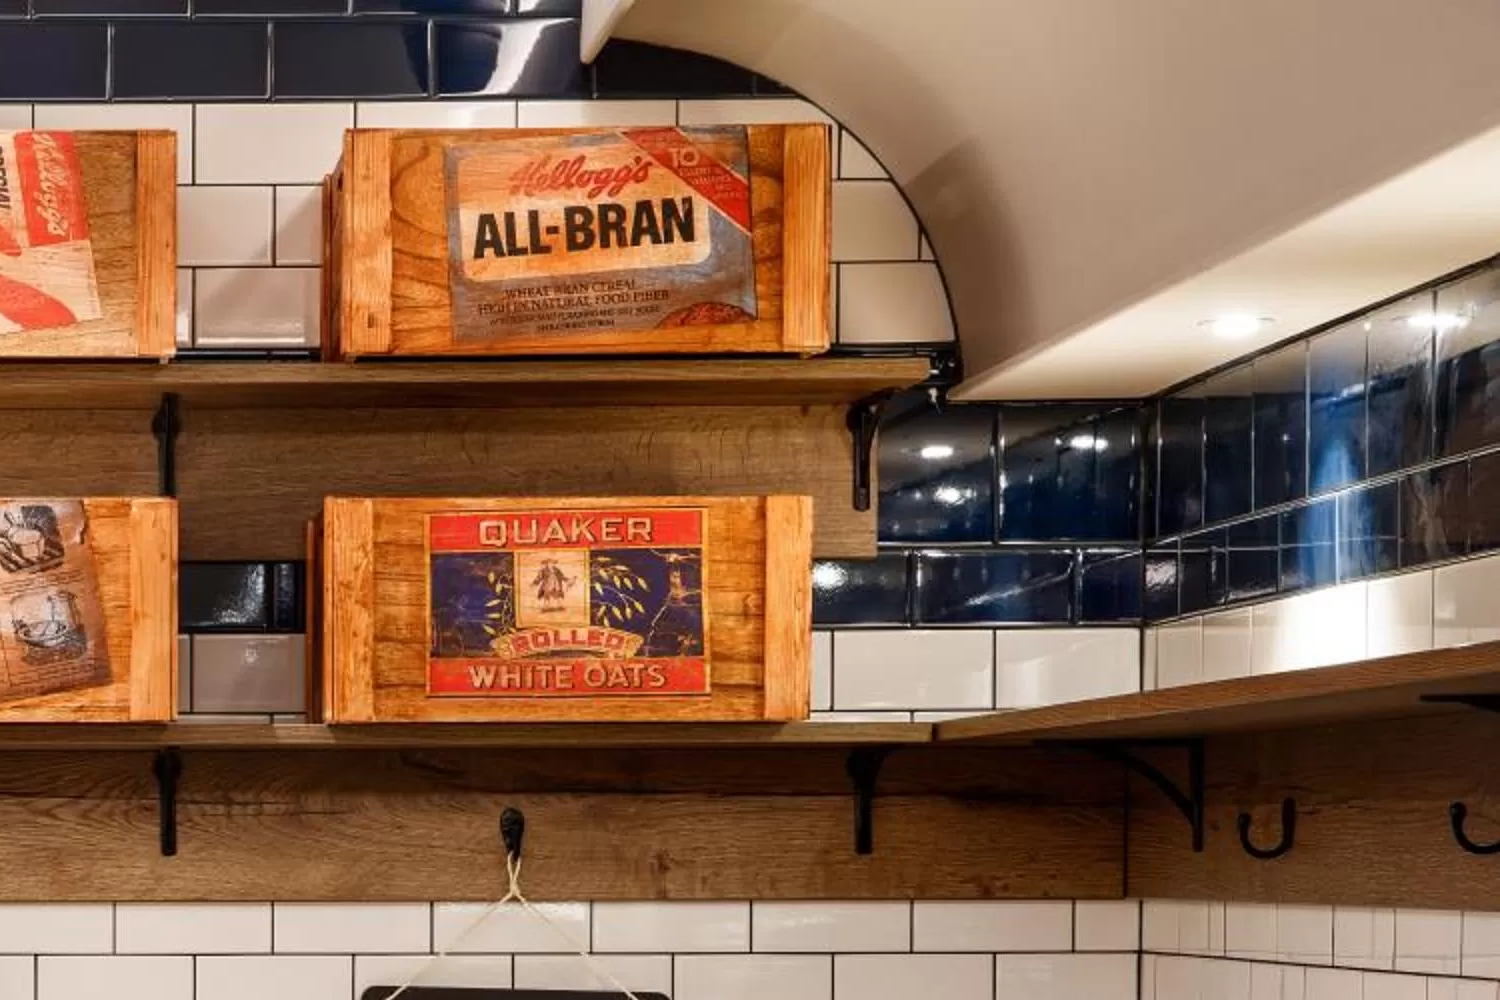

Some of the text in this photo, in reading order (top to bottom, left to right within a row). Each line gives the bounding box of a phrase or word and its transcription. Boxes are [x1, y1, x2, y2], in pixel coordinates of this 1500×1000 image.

[32, 133, 71, 238] Kellogg's
[507, 154, 655, 199] Kellogg's
[473, 196, 697, 260] ALL-BRAN
[479, 516, 653, 547] QUAKER
[511, 627, 626, 651] ROLLED
[468, 662, 667, 689] WHITE OATS
